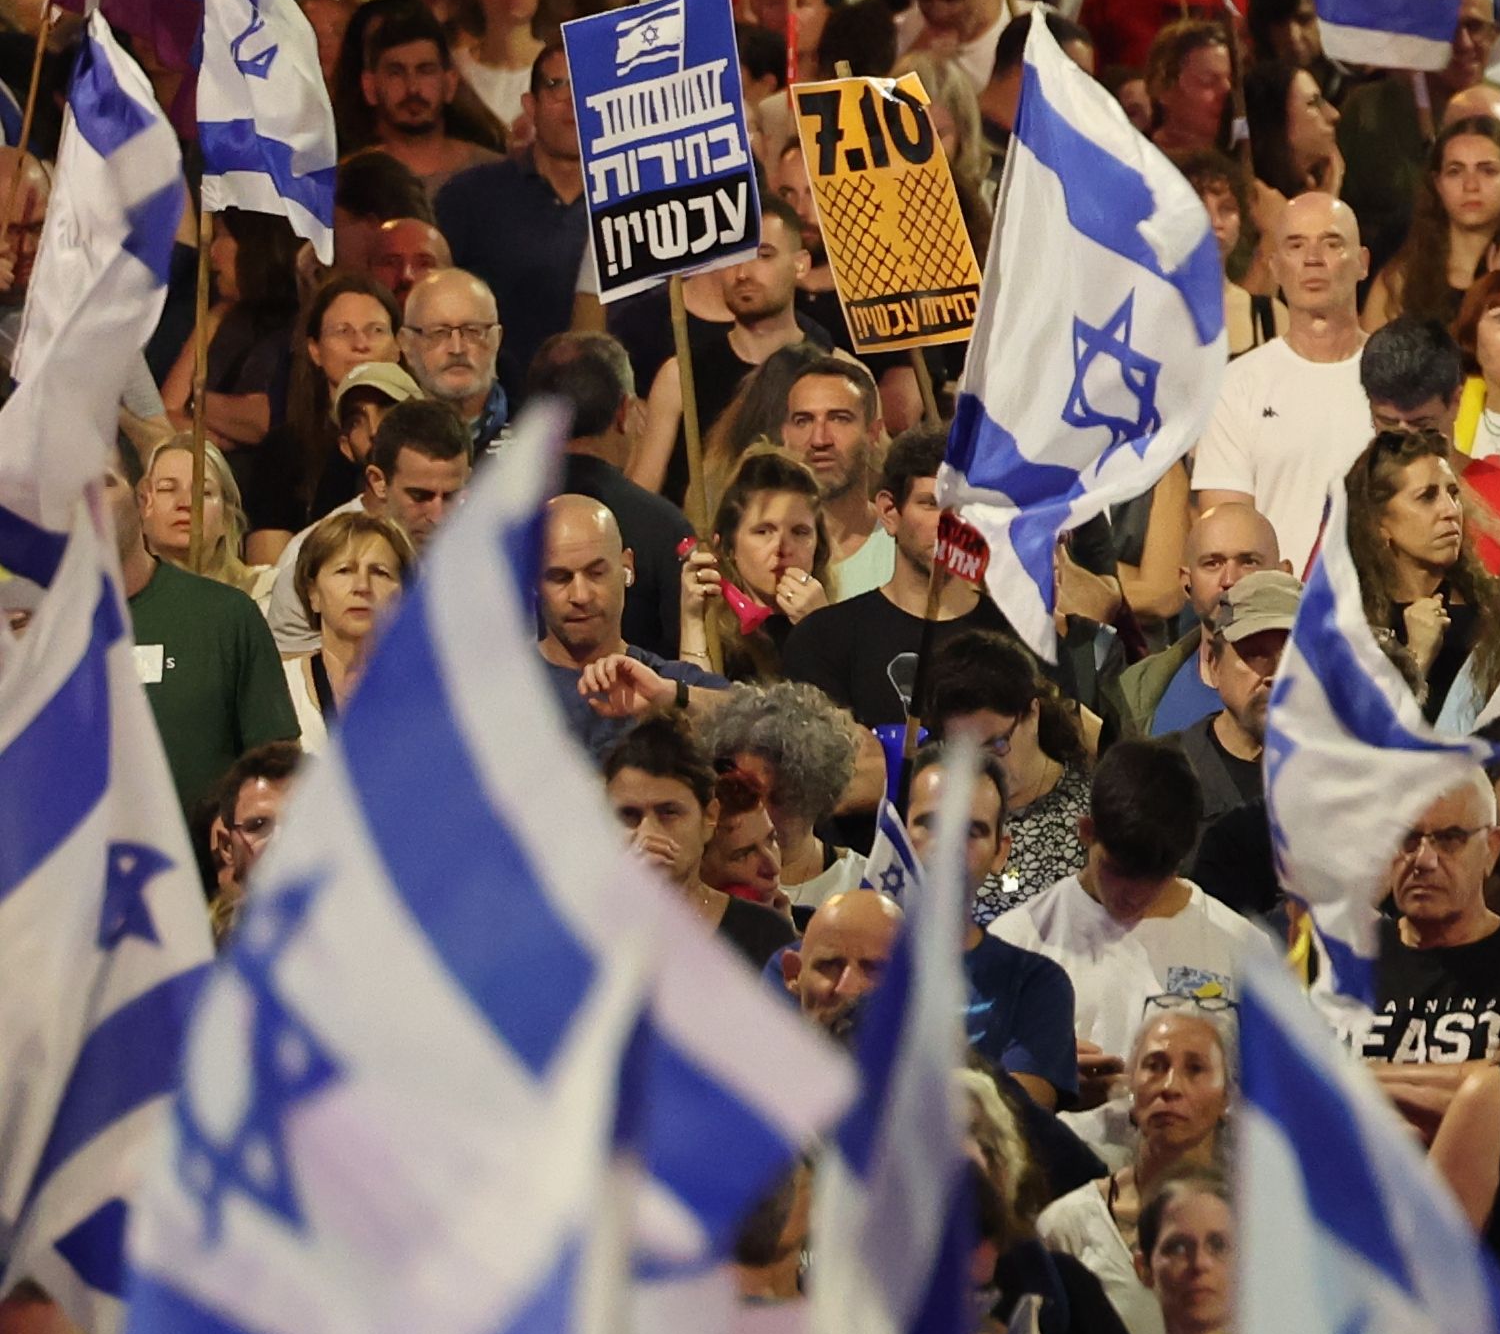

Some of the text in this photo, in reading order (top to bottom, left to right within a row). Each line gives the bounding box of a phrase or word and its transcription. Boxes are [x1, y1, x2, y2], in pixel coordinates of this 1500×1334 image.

[586, 122, 748, 205] בחירות
[797, 85, 935, 176] 7.10
[600, 181, 749, 277] עכשיו!
[851, 298, 920, 340] עכשיו!
[1384, 997, 1497, 1014] AININ
